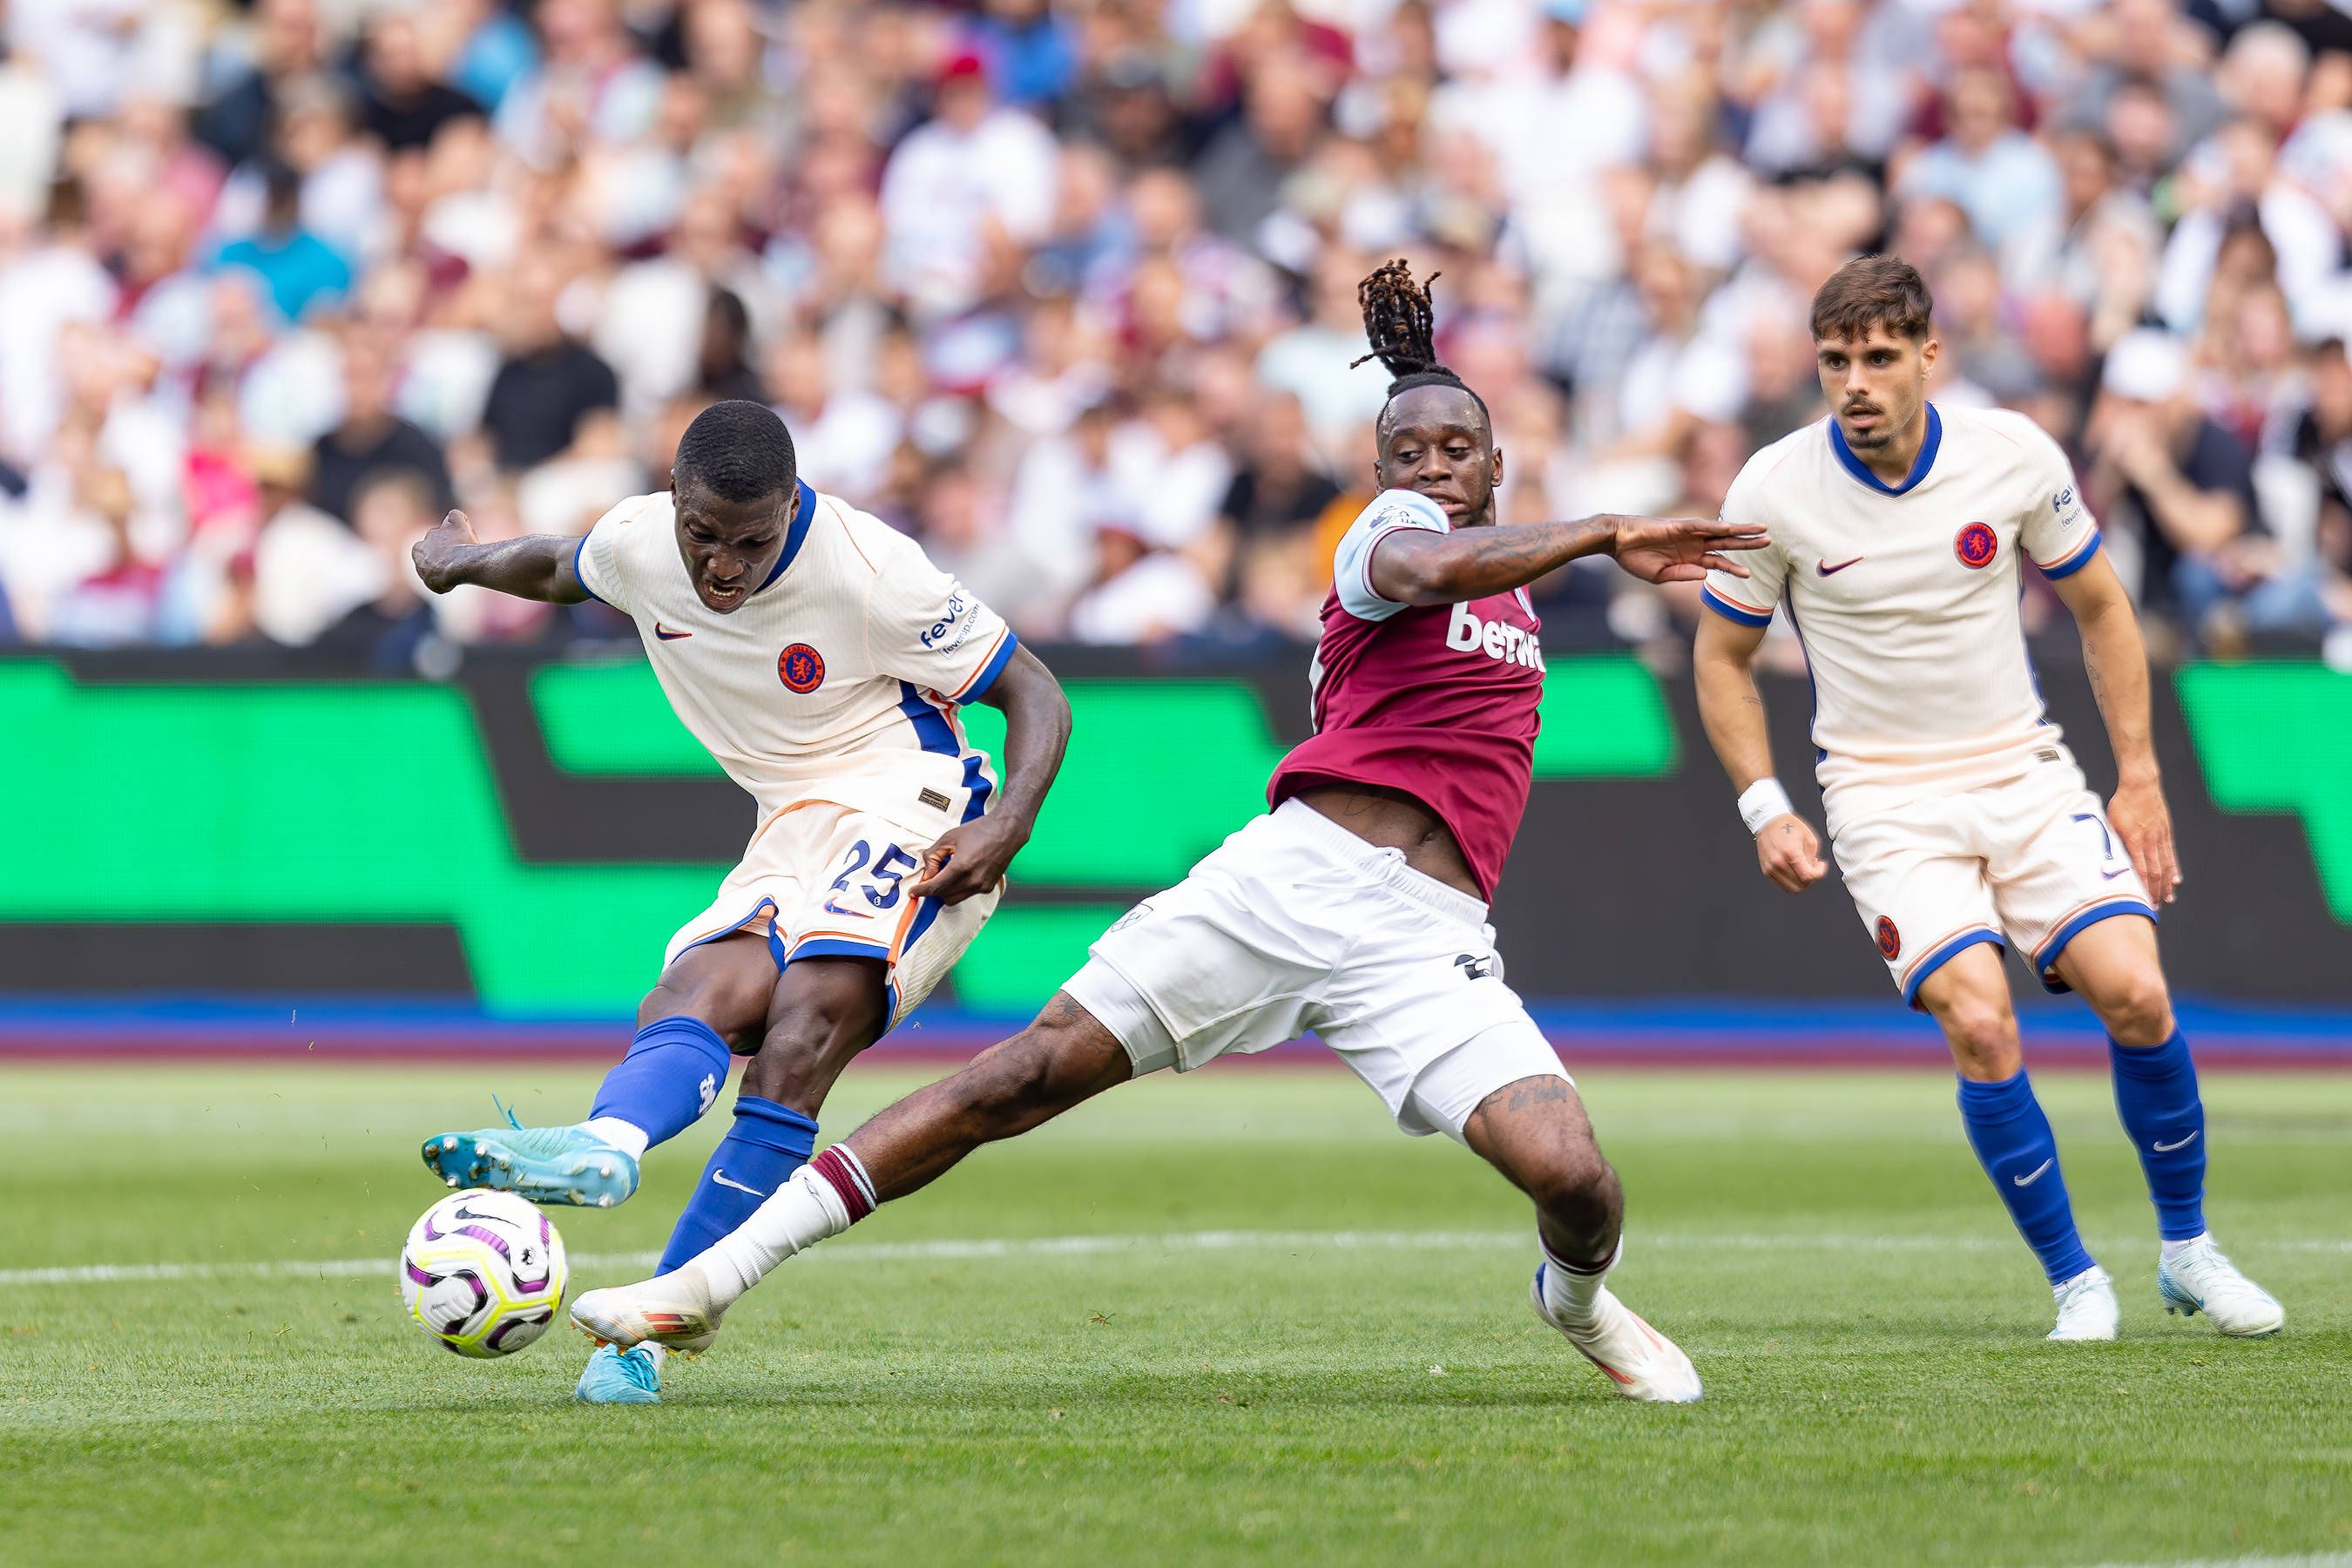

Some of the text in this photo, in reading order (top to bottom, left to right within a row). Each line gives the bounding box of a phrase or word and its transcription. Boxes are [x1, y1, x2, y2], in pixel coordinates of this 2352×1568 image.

[920, 591, 963, 649] fever
[2070, 813, 2113, 861] 7
[827, 840, 917, 909] 25
